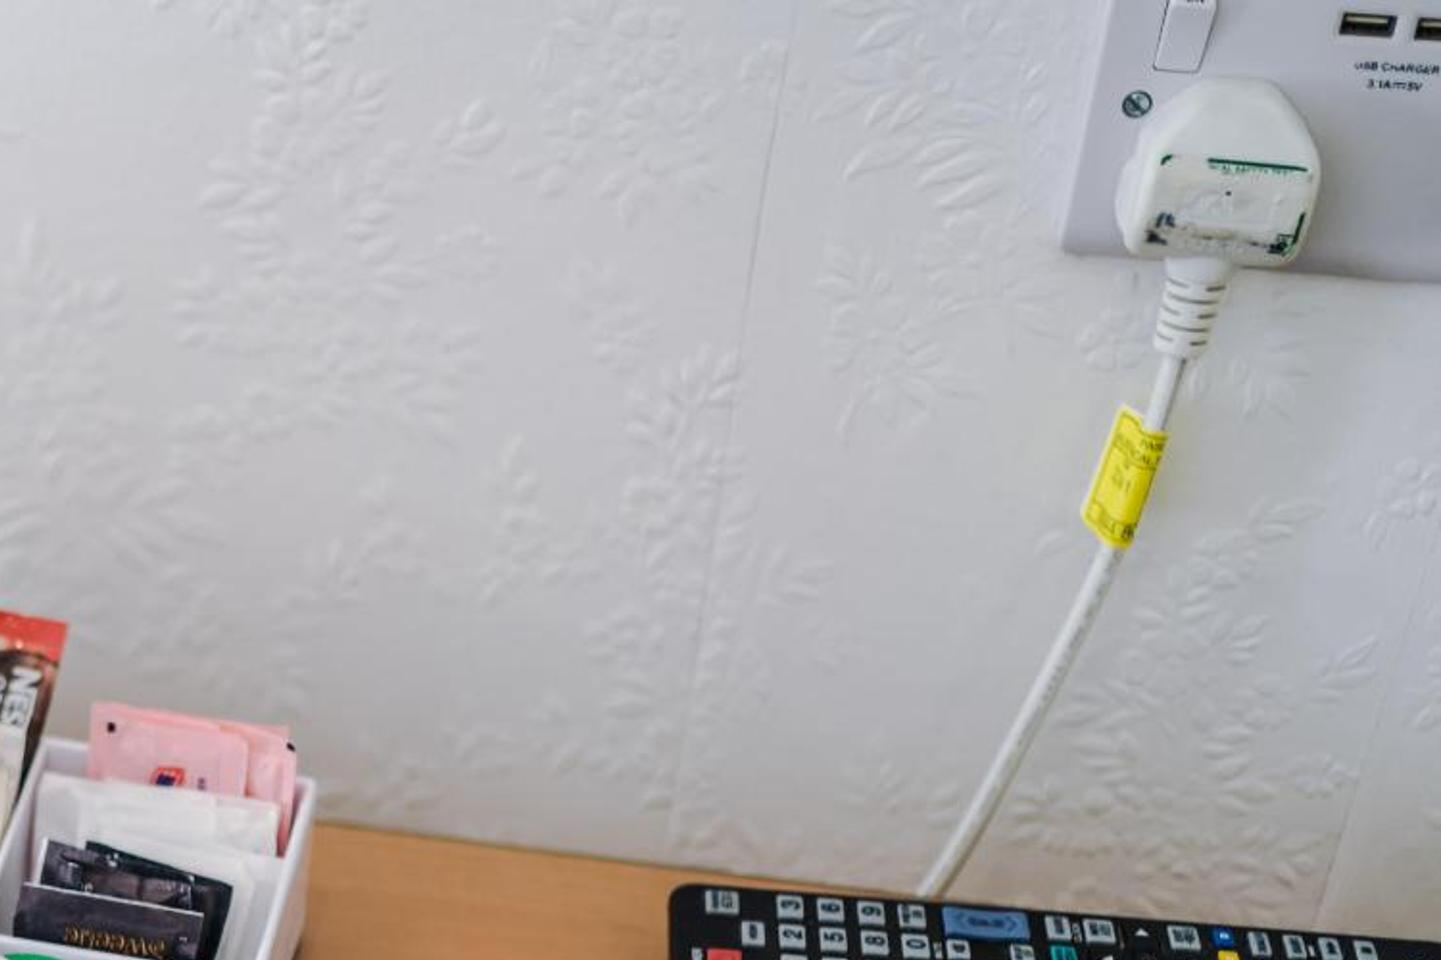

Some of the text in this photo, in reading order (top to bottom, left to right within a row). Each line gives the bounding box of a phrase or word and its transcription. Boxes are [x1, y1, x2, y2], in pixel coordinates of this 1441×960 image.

[1354, 61, 1440, 75] USB CHARGER
[780, 900, 801, 911] 3
[820, 903, 840, 913] 6
[861, 906, 881, 916] 9
[782, 928, 803, 940] 2
[823, 931, 844, 943] 5
[864, 935, 885, 946] 8
[905, 938, 926, 949] 0
